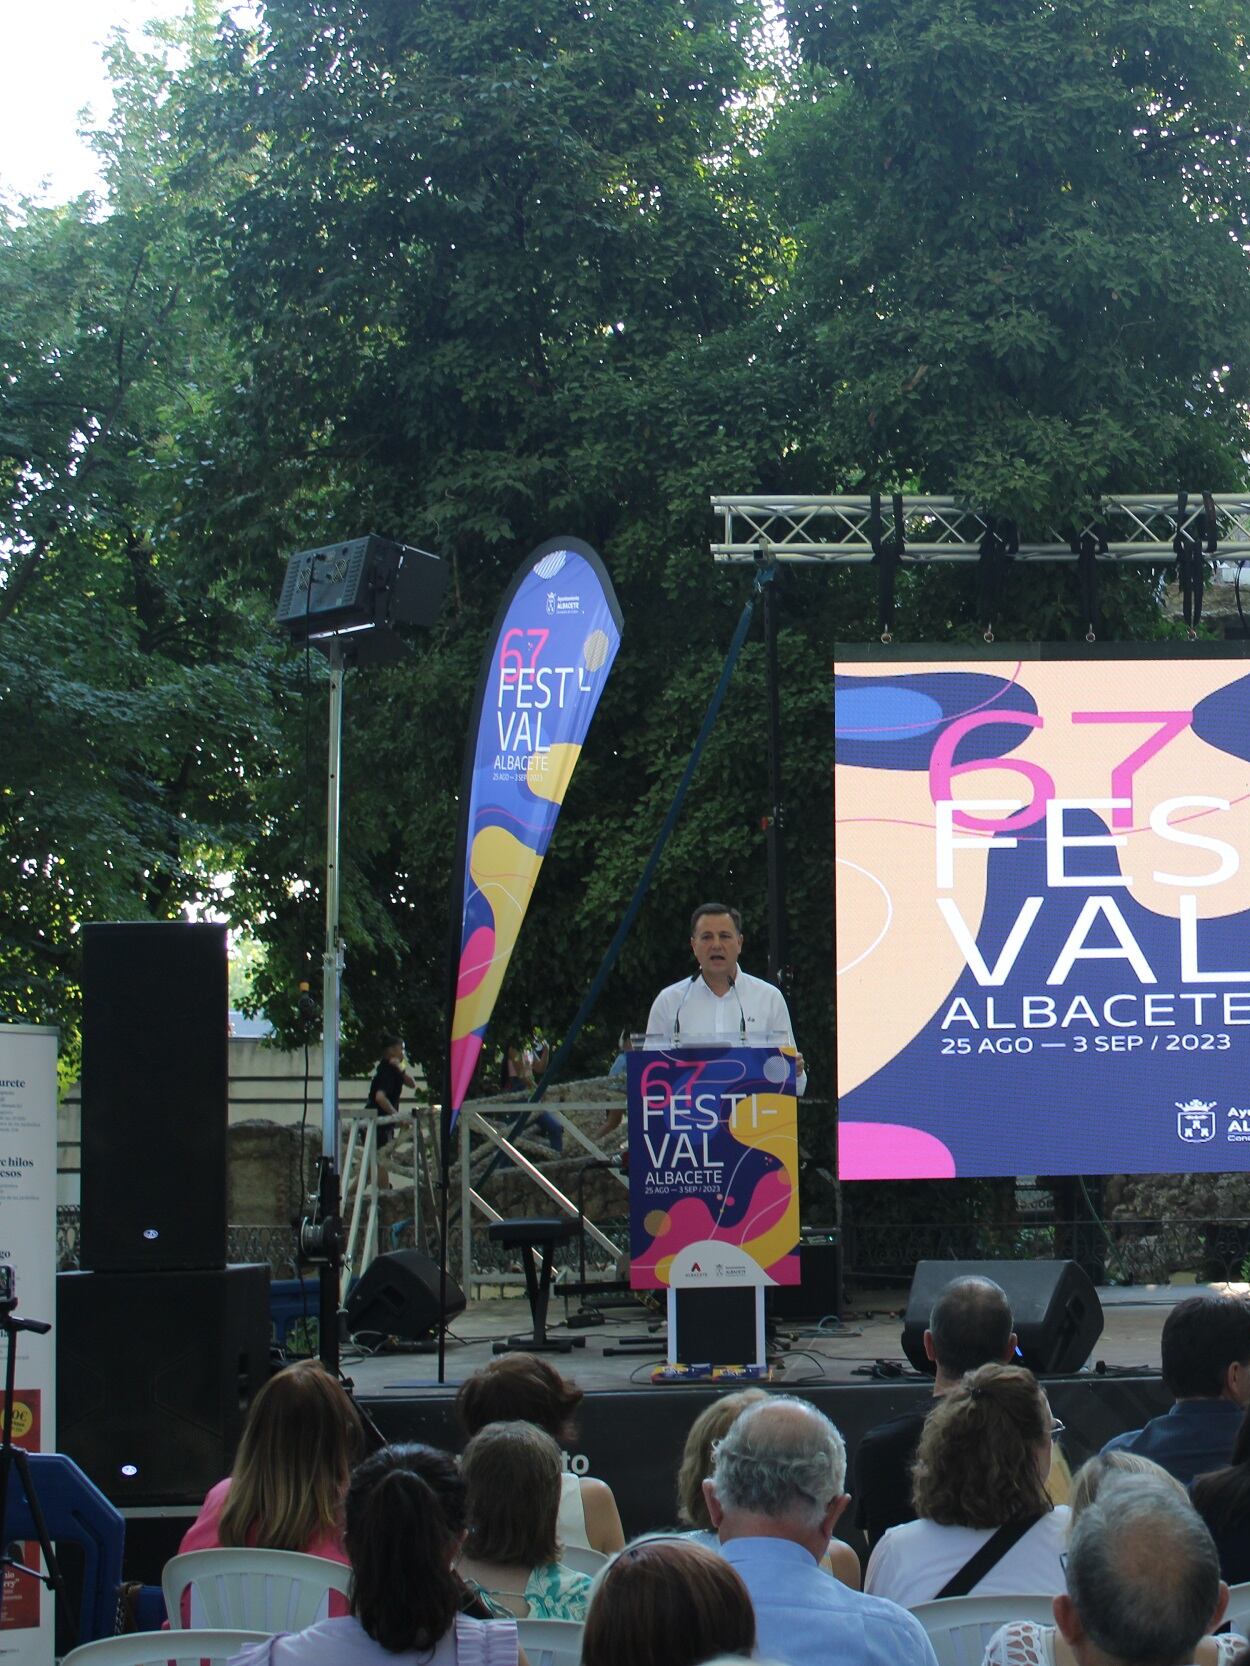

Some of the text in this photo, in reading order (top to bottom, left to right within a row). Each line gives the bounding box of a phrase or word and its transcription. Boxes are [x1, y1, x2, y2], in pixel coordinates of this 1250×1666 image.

[500, 628, 550, 682] 67
[498, 711, 550, 752] VAL
[494, 755, 549, 771] ALBACETE
[928, 709, 1194, 831] 67
[941, 1038, 972, 1055] 25
[977, 1037, 1034, 1054] AGO
[1073, 1036, 1088, 1052] 3
[1094, 1035, 1144, 1052] SEP
[1166, 1034, 1231, 1051] 2023
[641, 1061, 706, 1109] 67
[642, 1093, 778, 1131] FESTI-
[644, 1132, 724, 1169] VAL
[645, 1170, 722, 1185] ALBACETE
[654, 1186, 669, 1194] AGO
[703, 1185, 720, 1193] 2023
